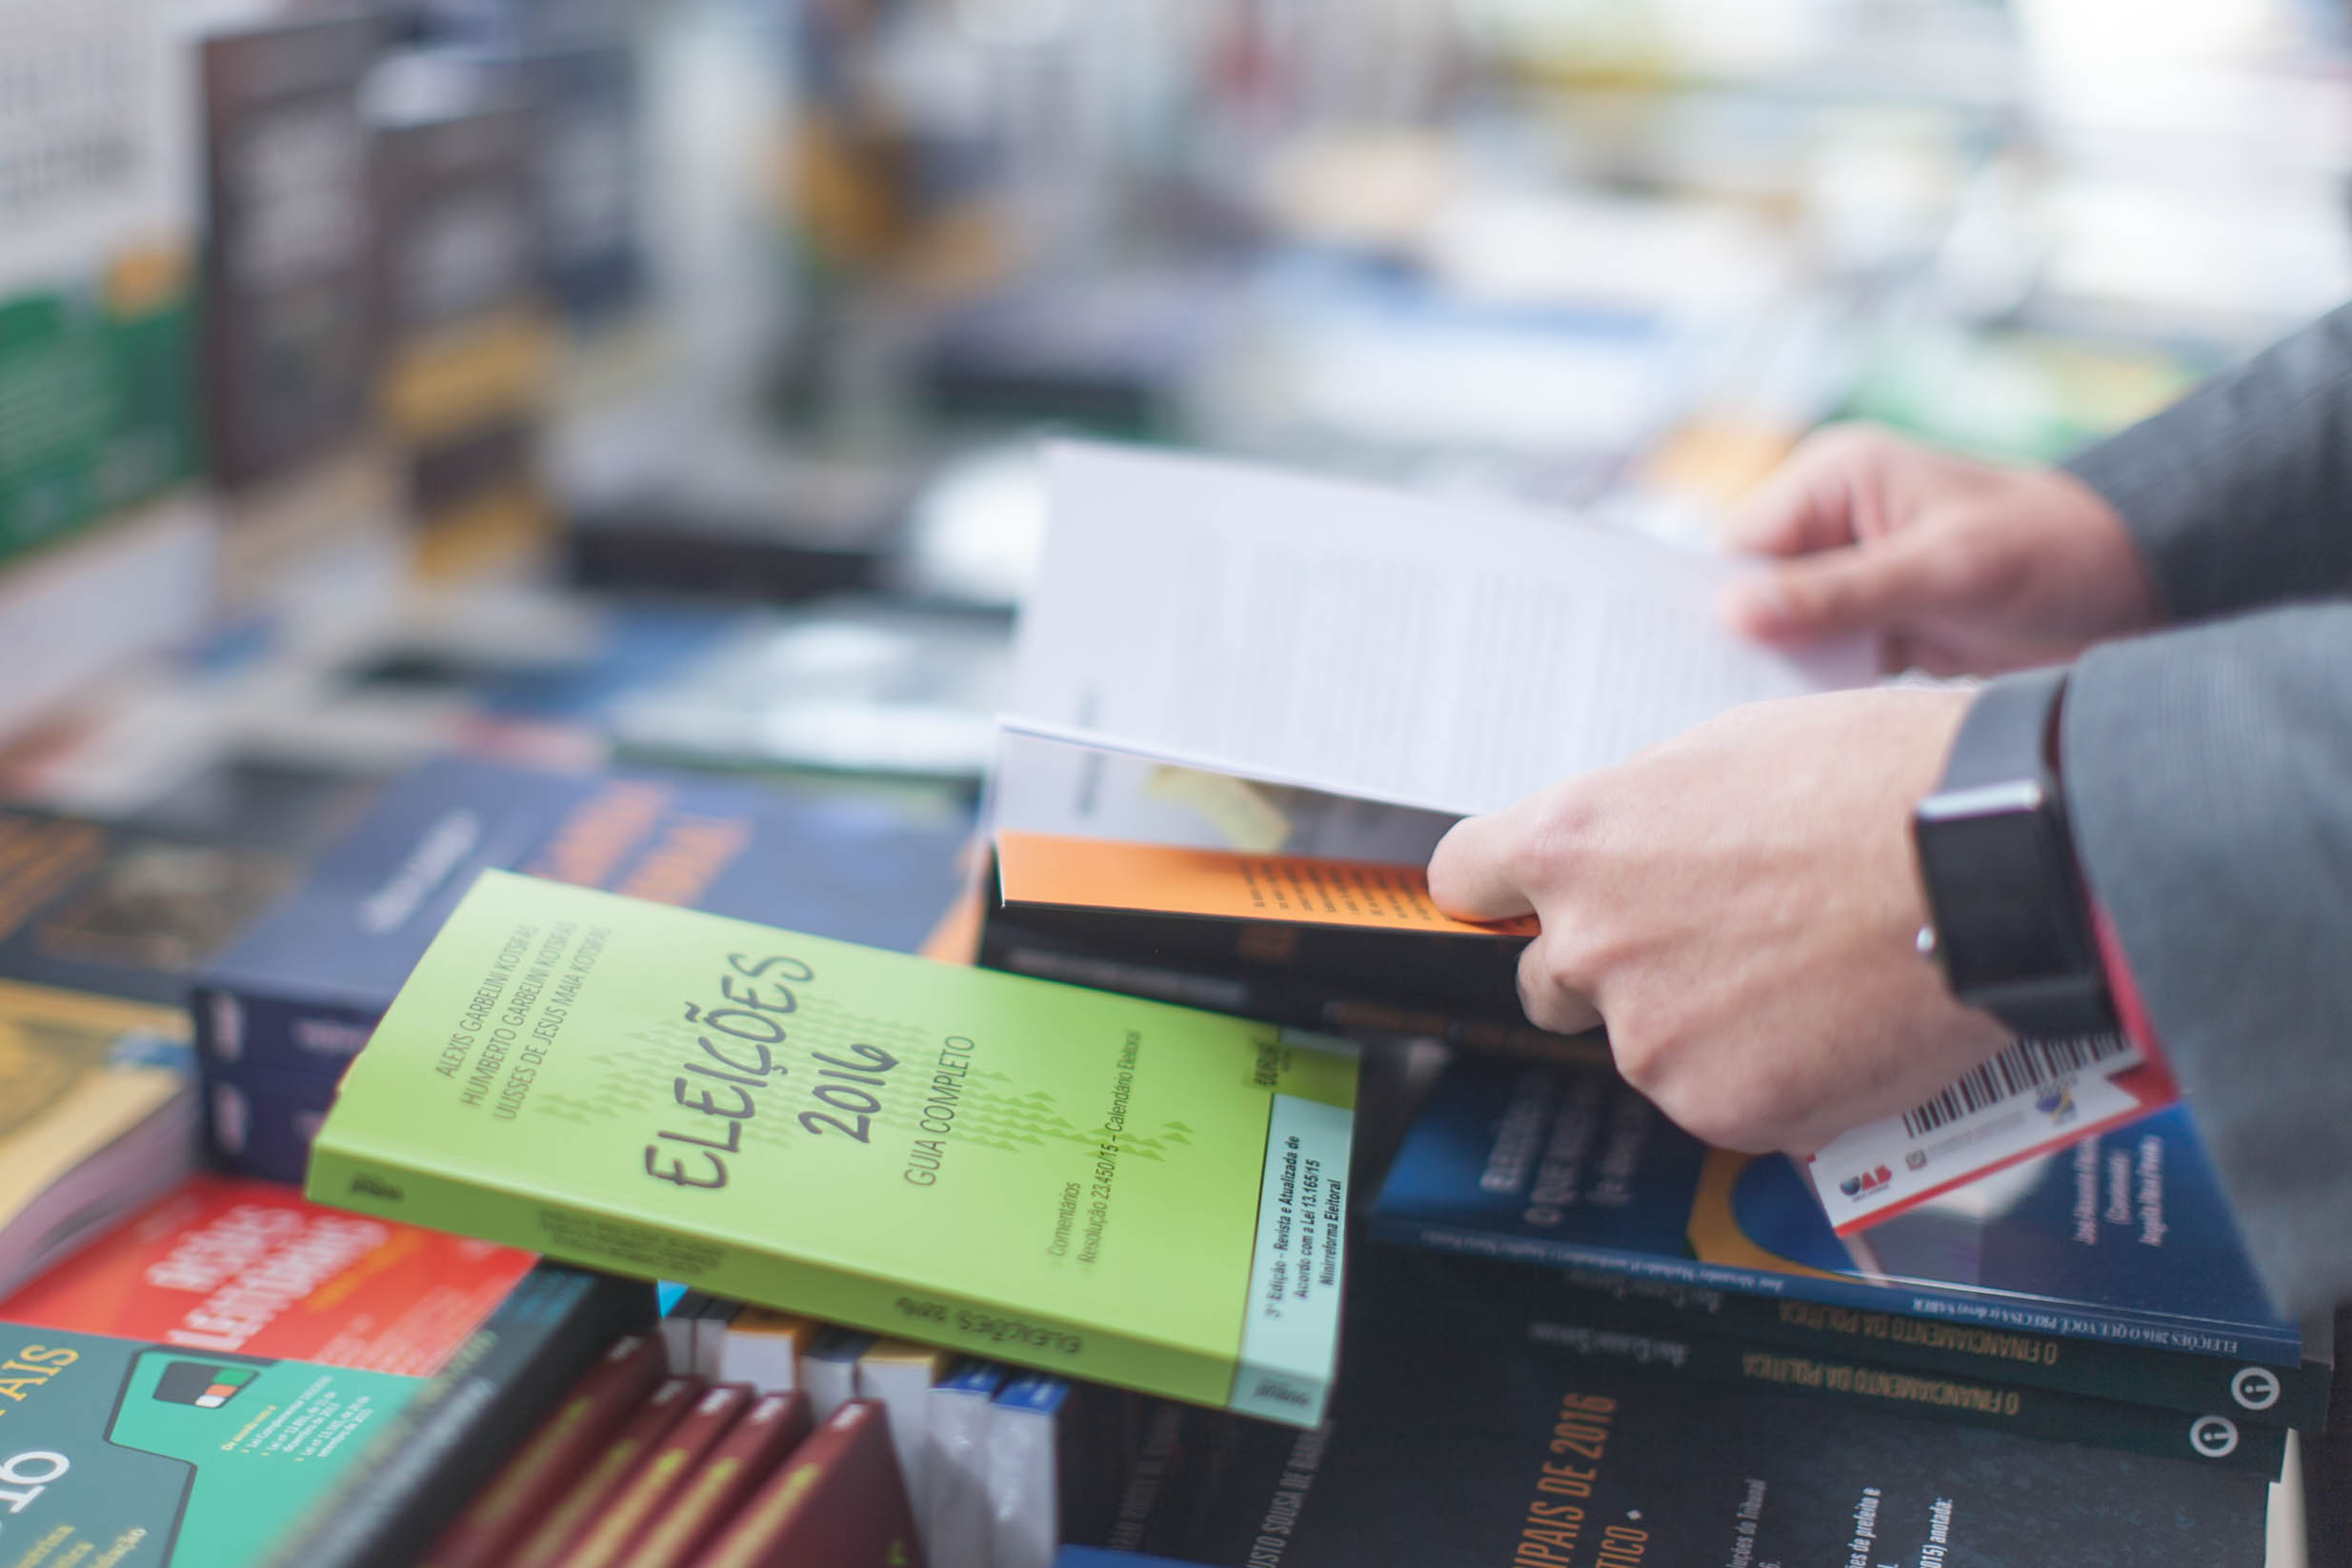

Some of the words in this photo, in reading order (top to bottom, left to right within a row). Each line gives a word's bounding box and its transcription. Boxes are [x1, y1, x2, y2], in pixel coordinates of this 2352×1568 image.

[550, 973, 587, 1007] MAIA
[434, 1033, 474, 1078] ALEXIS
[459, 970, 510, 1033] GARBELINI
[459, 1028, 517, 1107] HUMBERTO
[501, 967, 550, 1027] GARBELINI
[533, 1005, 568, 1045] JESUS
[520, 1043, 548, 1066] DE
[644, 953, 815, 1190] ELEIÇÕES
[493, 1066, 537, 1121] ULISSES
[797, 1043, 900, 1144] 2016
[919, 1035, 975, 1136] COMPLETO
[904, 1138, 947, 1189] GUIA
[1283, 1135, 1300, 1150] de
[1076, 1200, 1108, 1264] Resolução
[1105, 1071, 1134, 1134] Calendário
[1277, 1151, 1298, 1207] Atualizada
[1048, 1180, 1081, 1258] Comentários
[1299, 1208, 1317, 1226] Lei
[1323, 1178, 1342, 1222] Eleitoral
[1273, 1215, 1292, 1252] Revista
[1300, 1233, 1314, 1256] com
[1266, 1258, 1287, 1302] Edição
[1293, 1257, 1312, 1300] Acordo
[2060, 1317, 2098, 1336] VOCÊ
[2102, 1323, 2129, 1340] QUE
[2171, 1334, 2239, 1355] ELEIÇÕES
[2043, 1340, 2059, 1365] O
[1826, 1365, 1853, 1393] DA
[1856, 1370, 2002, 1414] FINANCIAMENTO
[2003, 1391, 2020, 1416] O
[1549, 1394, 1617, 1459] 2016
[1537, 1462, 1598, 1498] DE
[1861, 1486, 1882, 1498] e
[1261, 1491, 1303, 1536] SOUSA
[1852, 1496, 1880, 1538] prefeito
[1846, 1537, 1872, 1552] de
